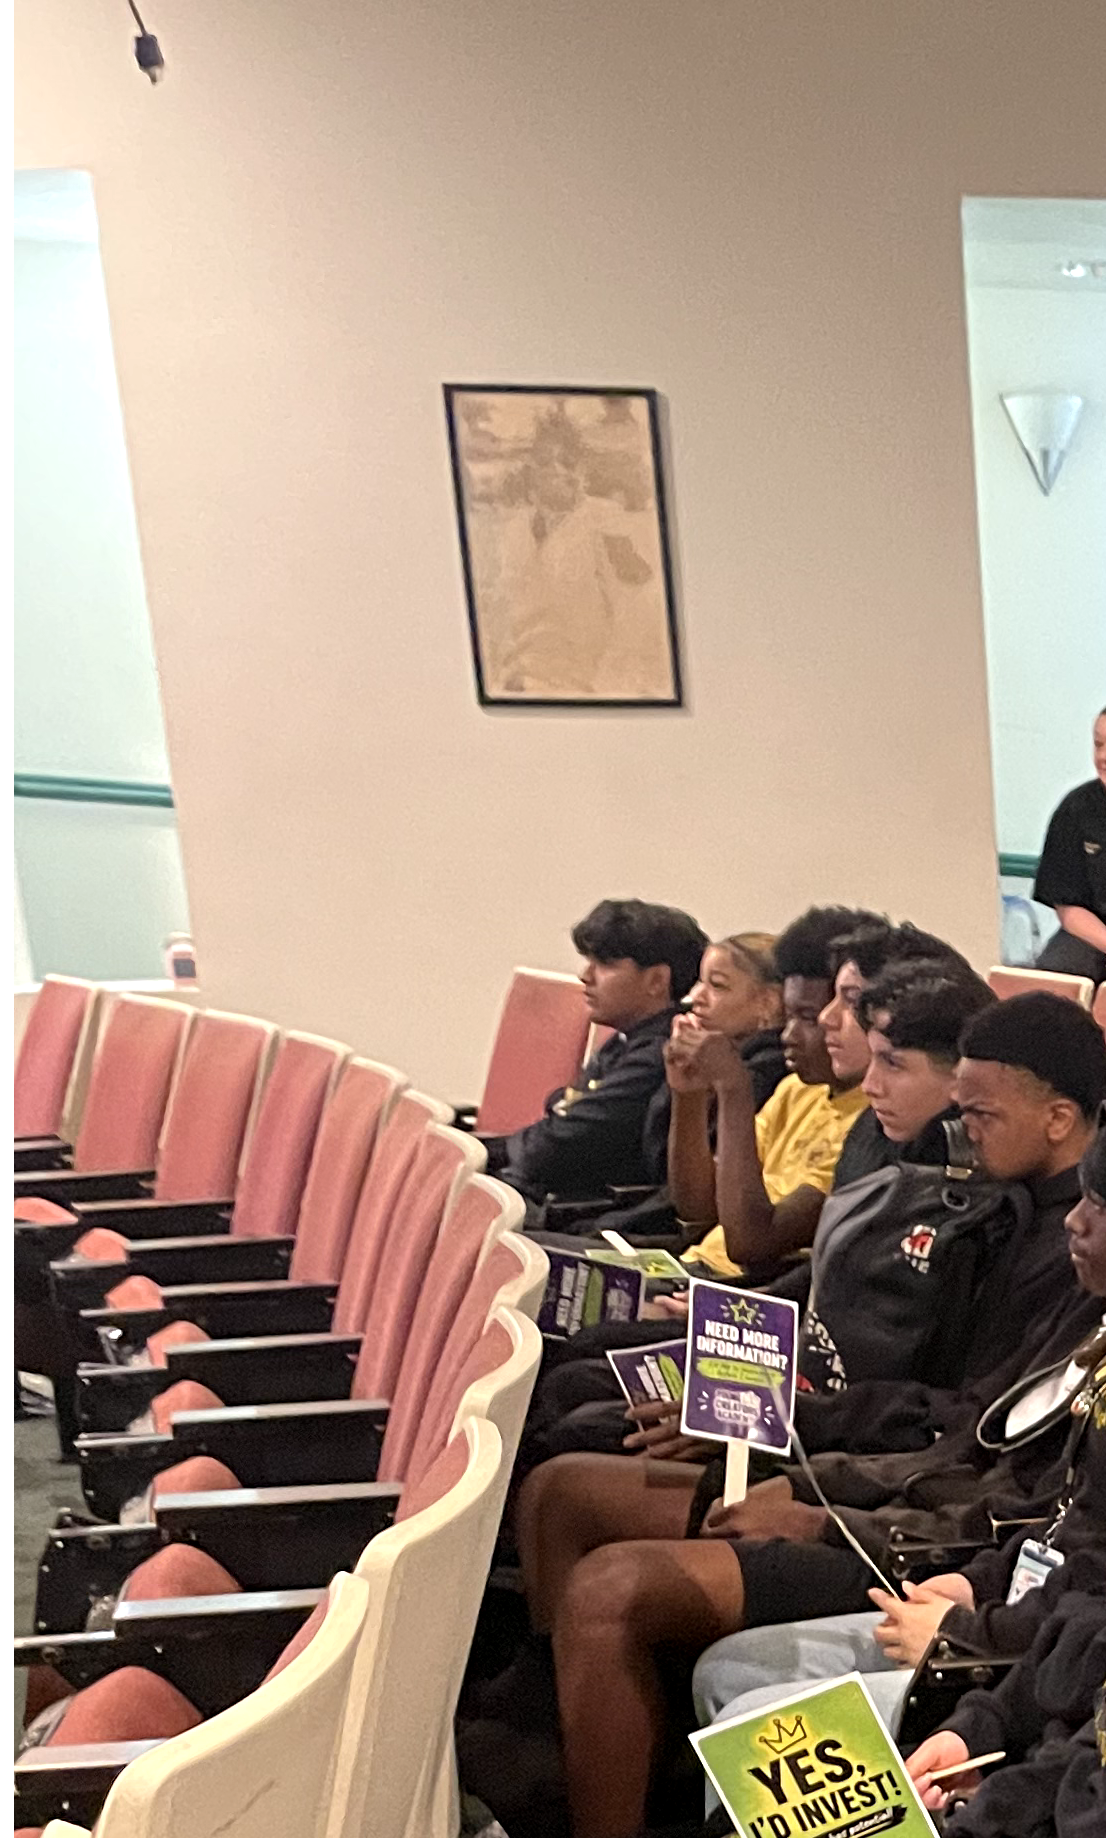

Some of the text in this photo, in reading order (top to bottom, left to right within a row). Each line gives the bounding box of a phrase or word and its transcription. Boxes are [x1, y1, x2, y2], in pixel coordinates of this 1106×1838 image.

[697, 1335, 789, 1370] INFORMATION?
[705, 1320, 780, 1351] NEED MORE
[747, 1739, 866, 1805] YES,
[791, 1769, 902, 1832] INVEST!
